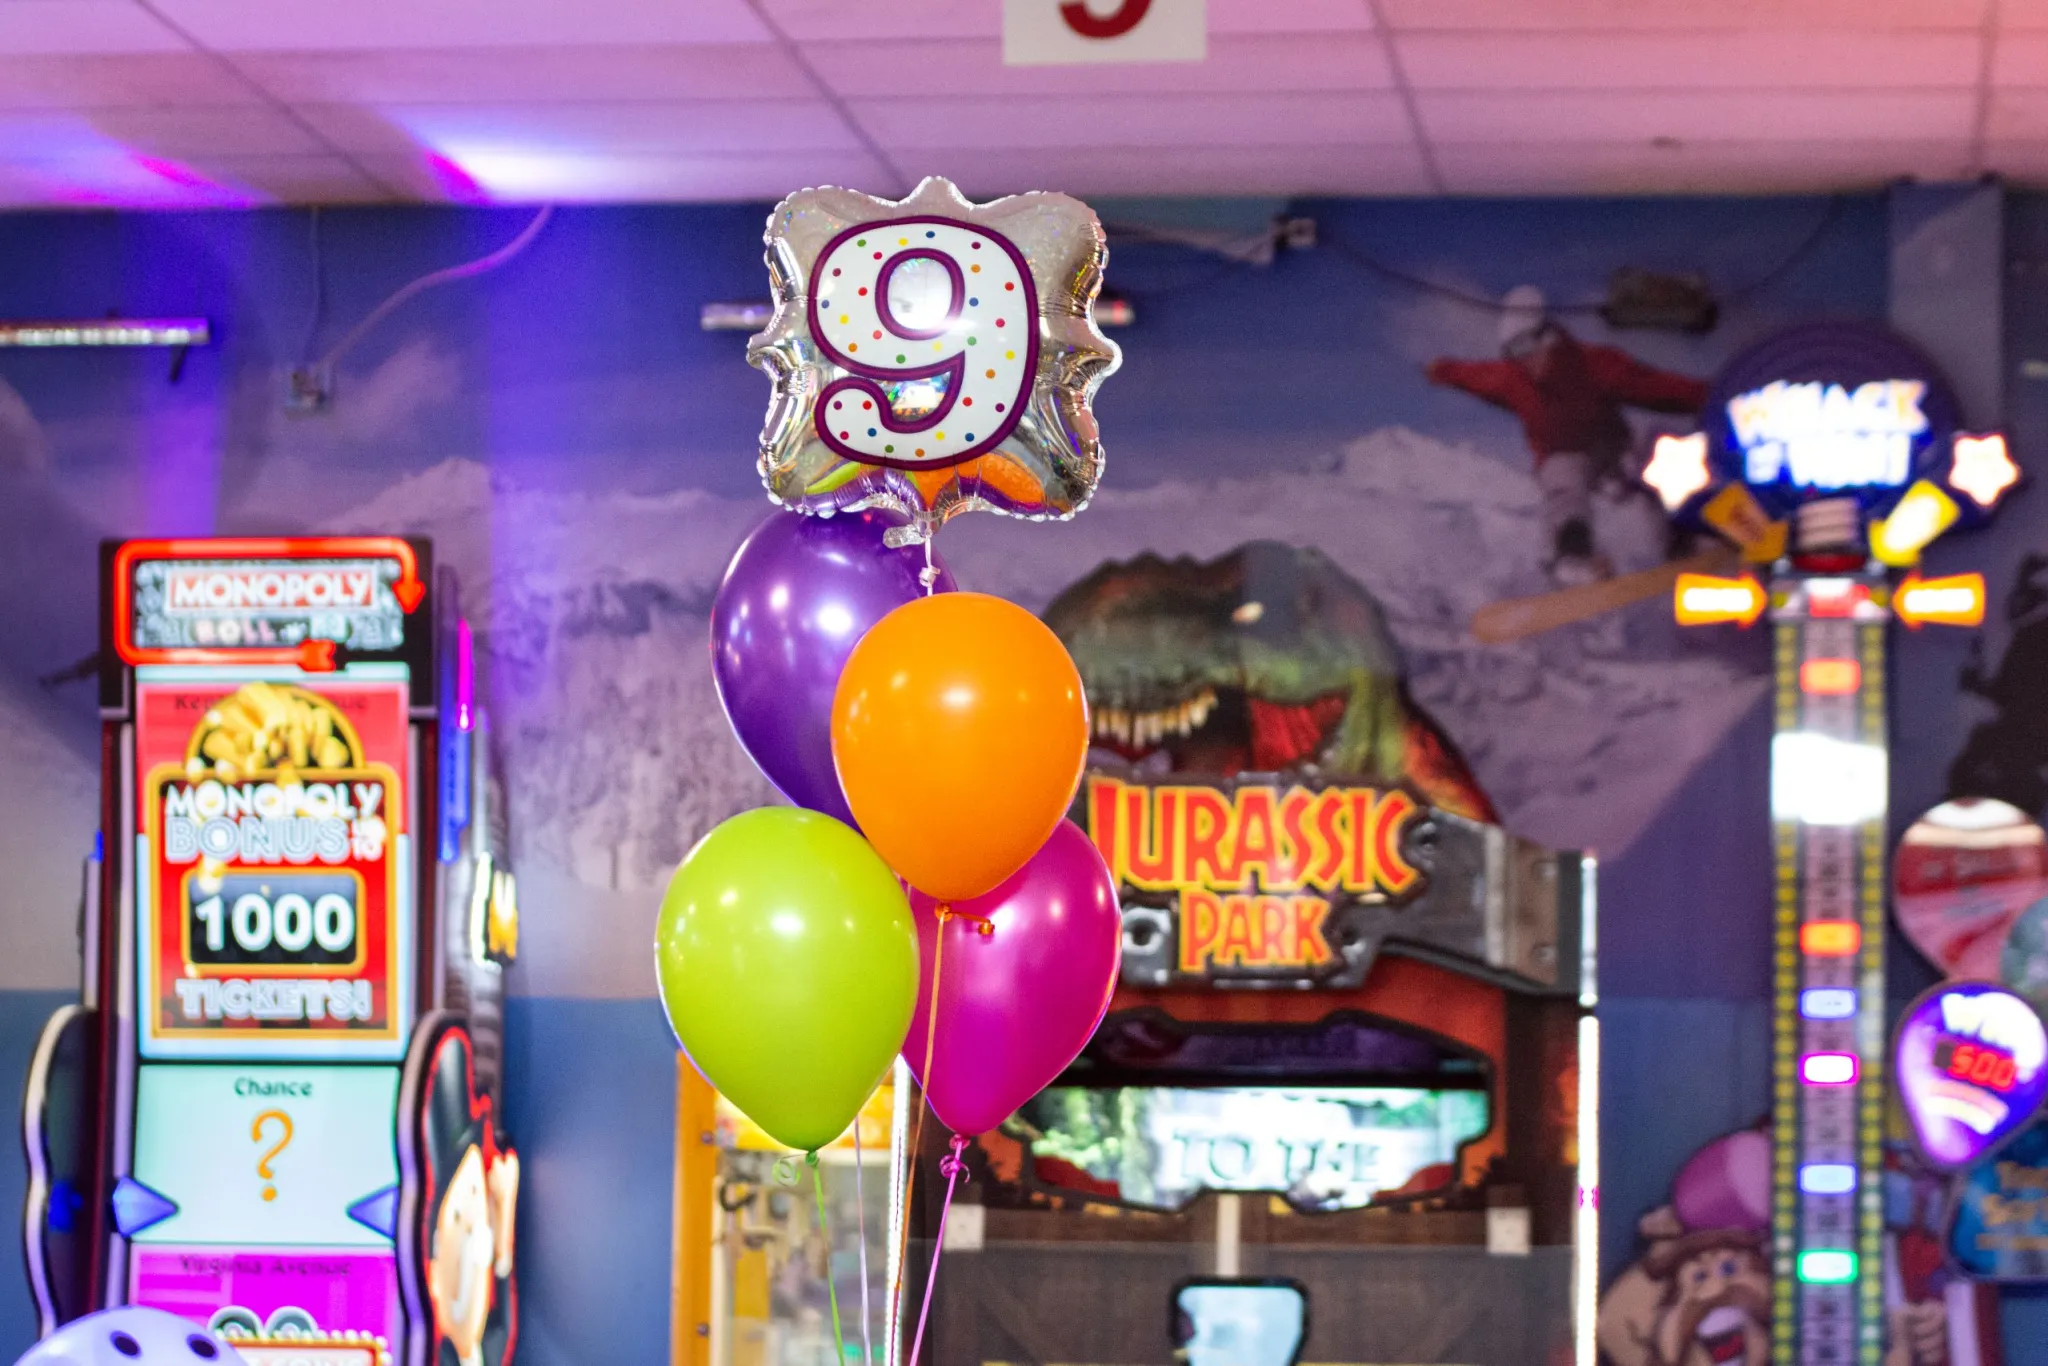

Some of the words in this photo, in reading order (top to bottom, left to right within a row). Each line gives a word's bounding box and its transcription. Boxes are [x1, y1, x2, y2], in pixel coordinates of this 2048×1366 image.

[808, 215, 1039, 471] 9
[174, 572, 370, 608] MONOPOLY
[164, 780, 384, 820] MONOPOLY
[165, 815, 350, 864] BONUS
[1086, 773, 1420, 893] JURASSIC
[195, 893, 355, 951] 1000
[1178, 884, 1333, 974] PARK
[174, 978, 373, 1020] TICKETS!
[233, 1076, 314, 1098] Chance
